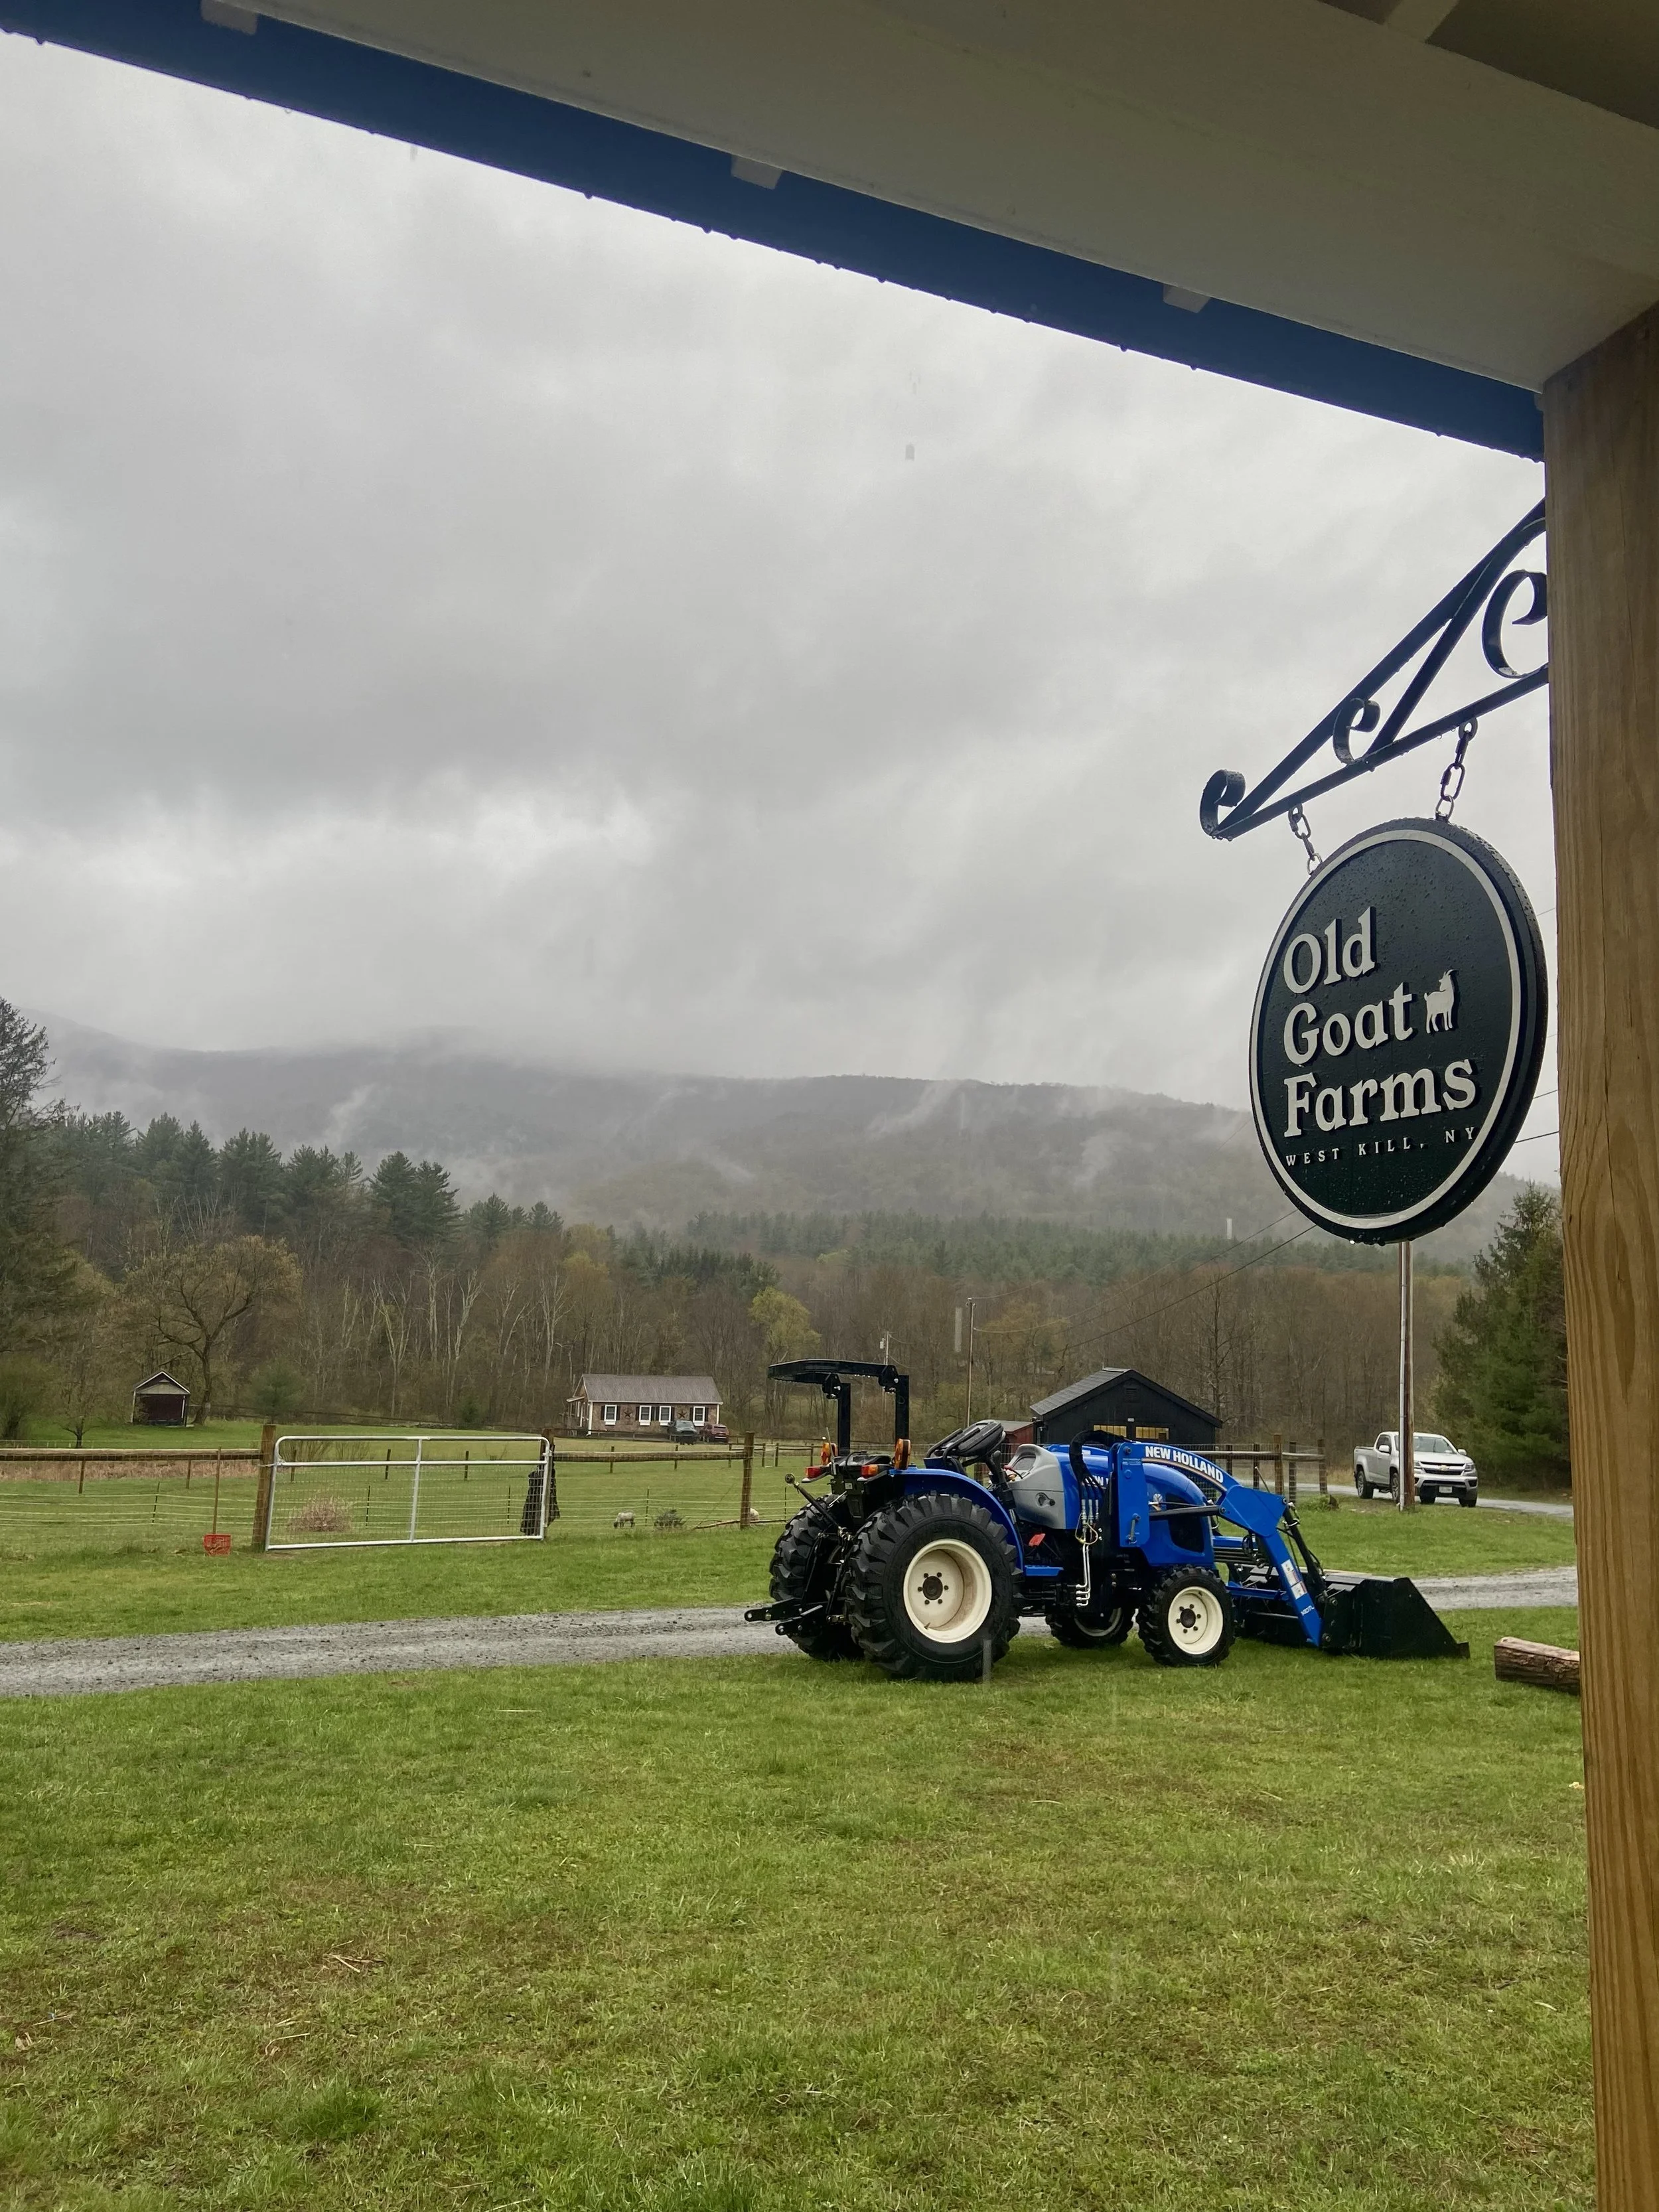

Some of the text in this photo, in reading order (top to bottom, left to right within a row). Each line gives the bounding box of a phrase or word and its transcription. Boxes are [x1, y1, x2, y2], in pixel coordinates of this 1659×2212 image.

[1283, 907, 1376, 994] Old
[1283, 982, 1413, 1065] Goat
[1283, 1059, 1477, 1138] Farms
[1285, 1126, 1475, 1166] WEST KILL, NY
[1145, 1445, 1224, 1483] NEW HOLLAND
